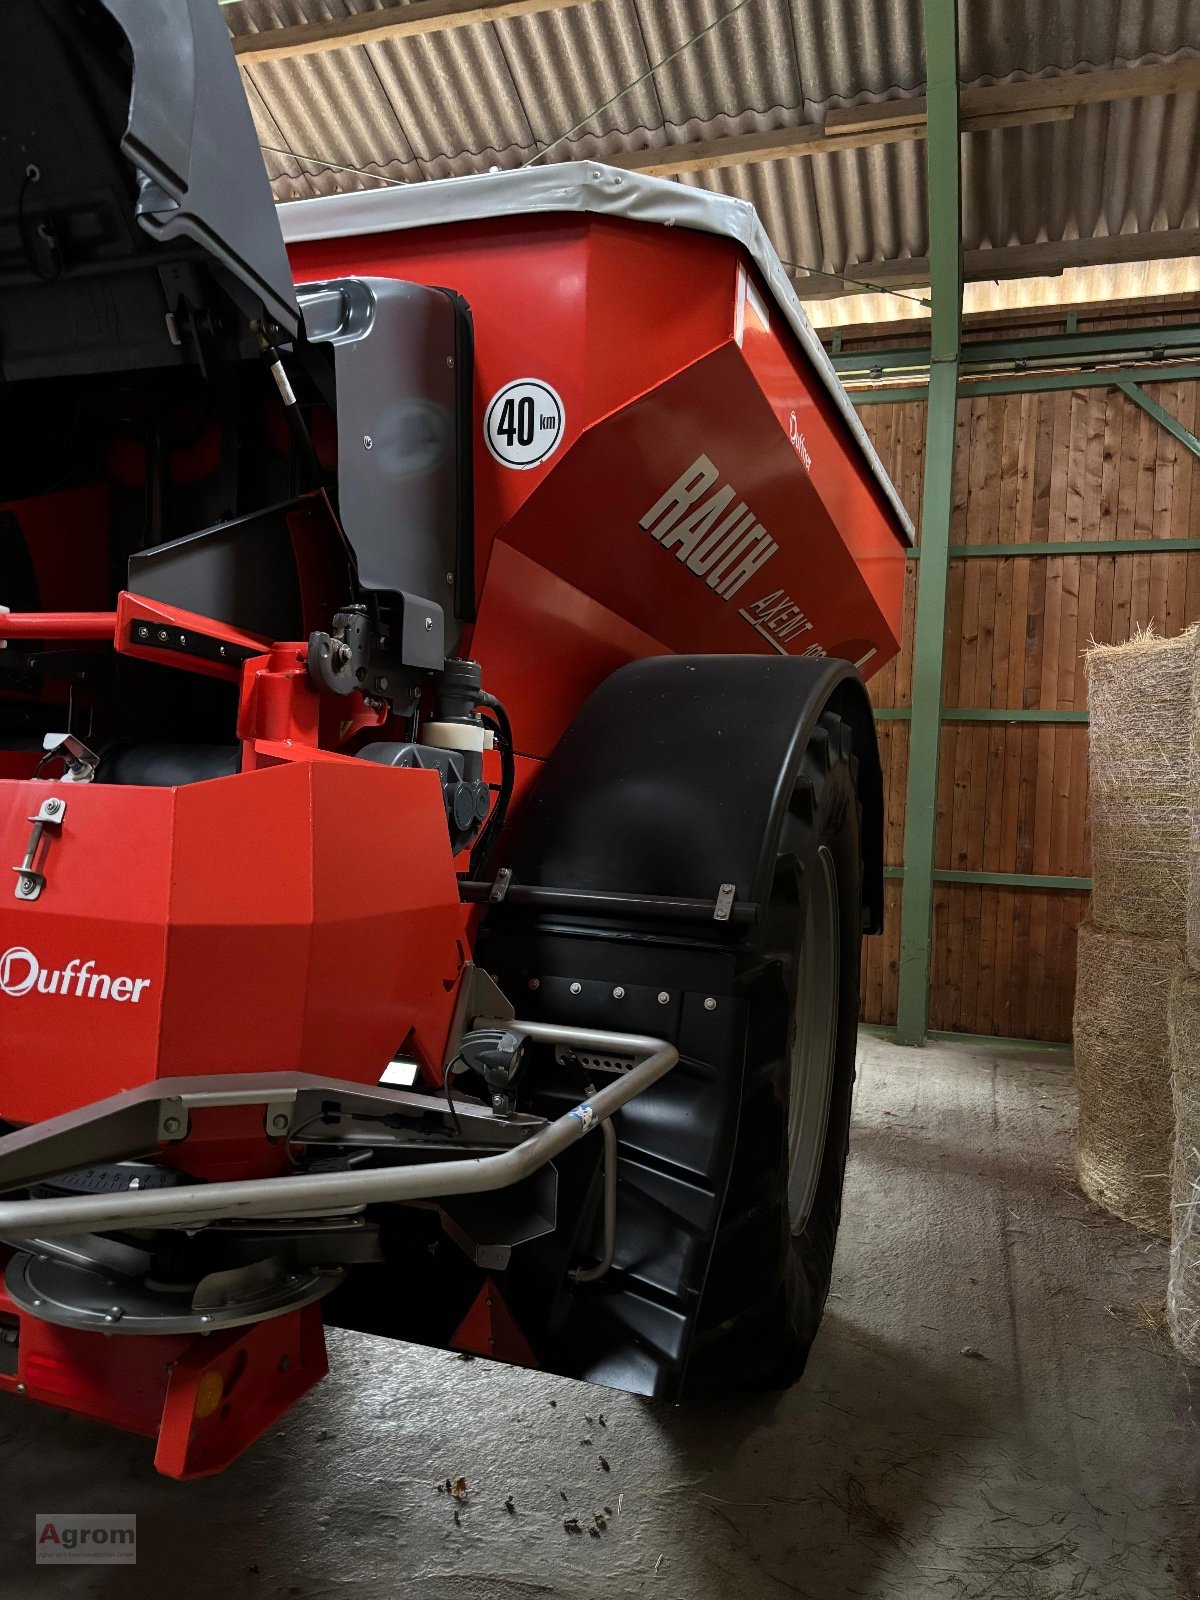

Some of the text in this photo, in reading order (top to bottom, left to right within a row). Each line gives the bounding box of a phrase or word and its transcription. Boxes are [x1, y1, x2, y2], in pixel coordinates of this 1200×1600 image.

[497, 396, 556, 446] 40 km
[790, 411, 811, 471] Duffner
[638, 453, 780, 601] RAUCH
[750, 589, 814, 643] AXENT
[0, 946, 150, 1003] Duffner
